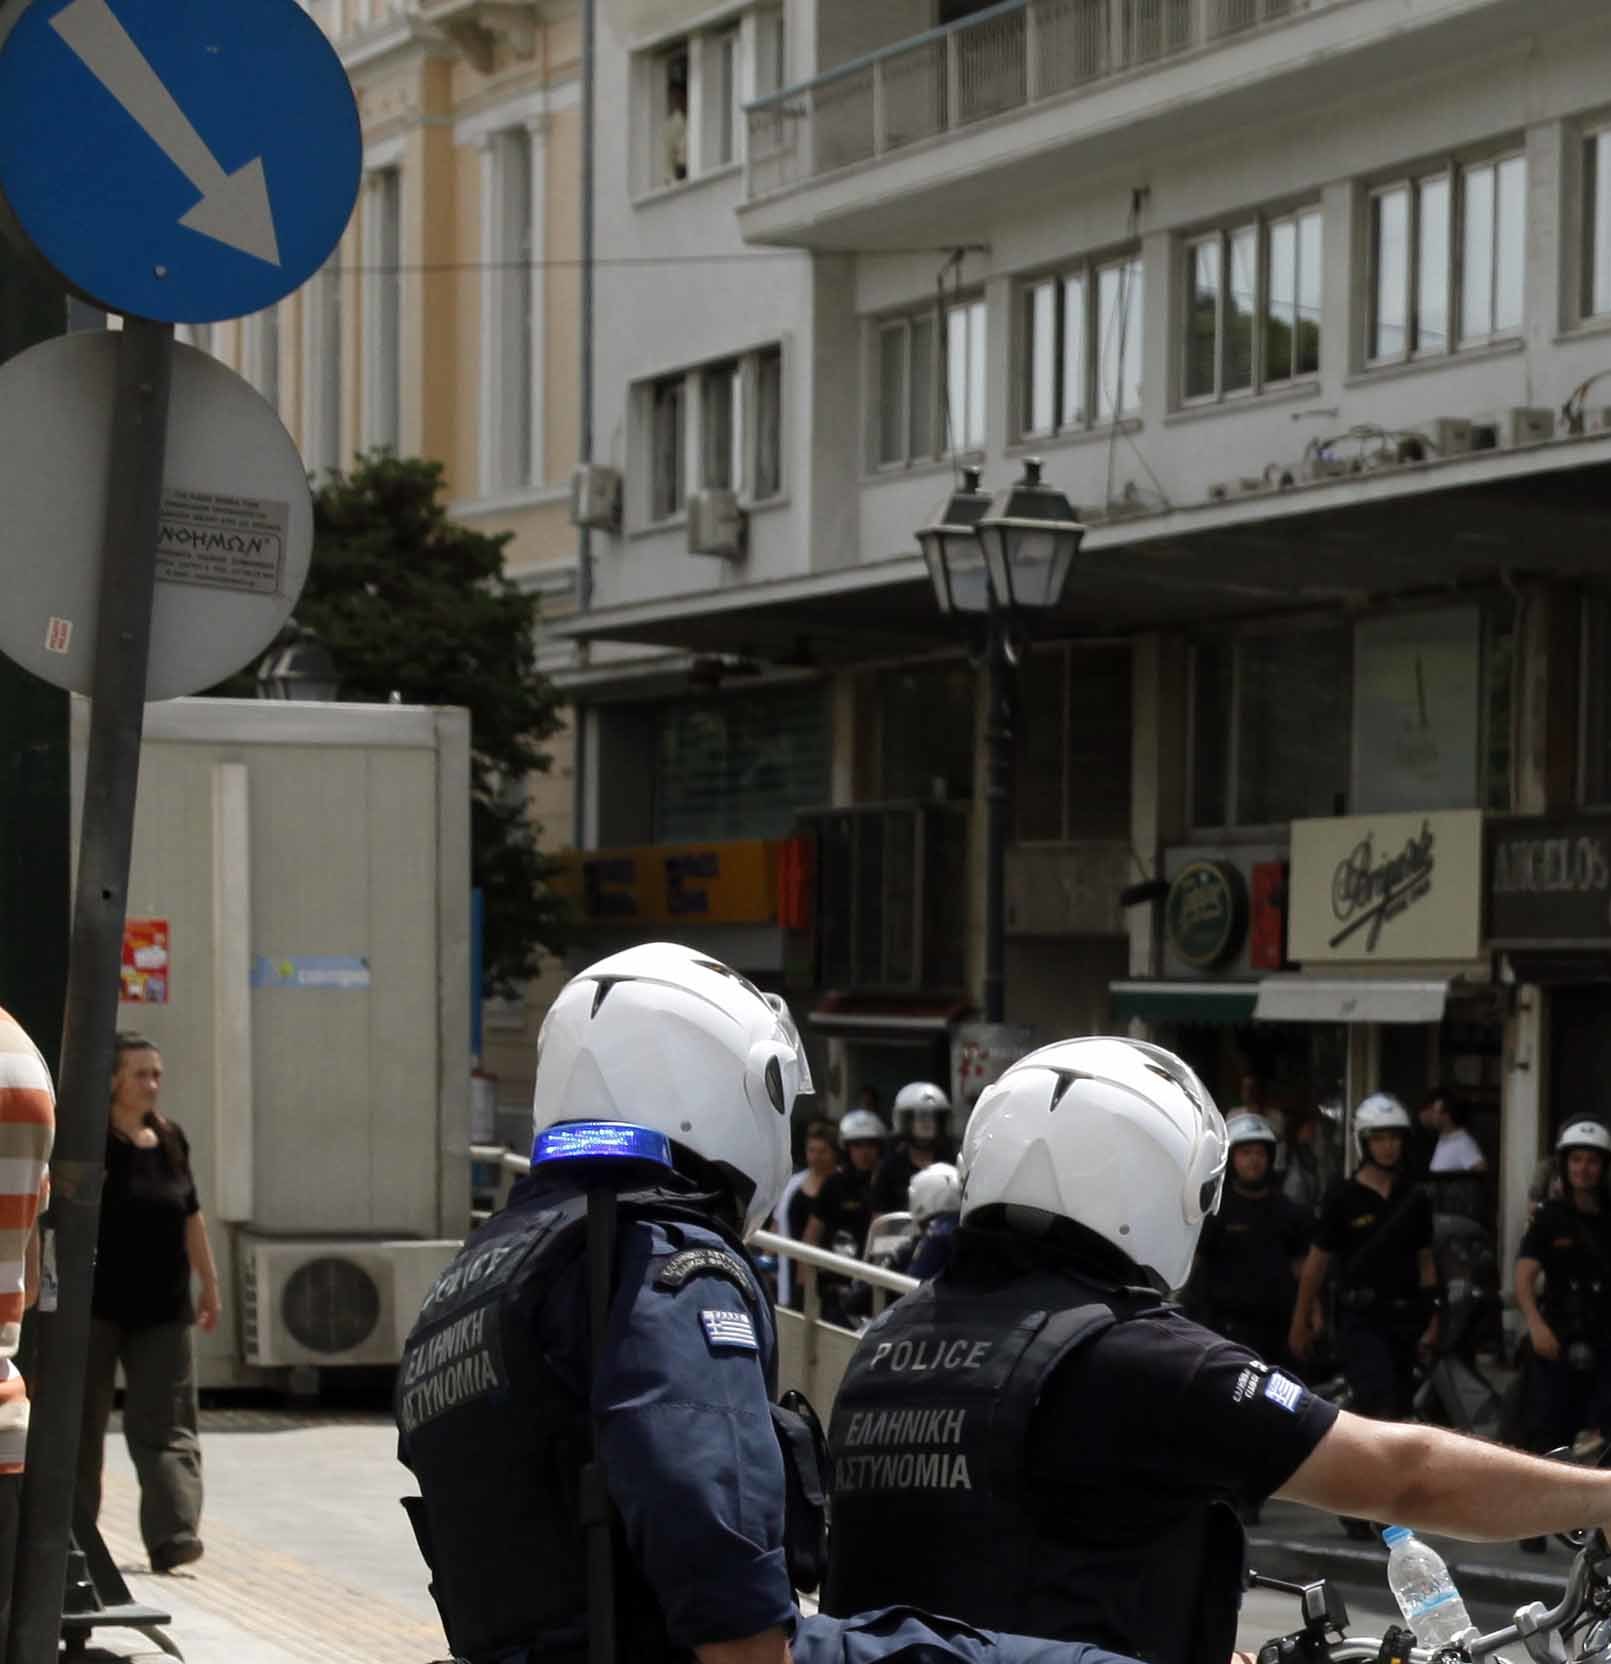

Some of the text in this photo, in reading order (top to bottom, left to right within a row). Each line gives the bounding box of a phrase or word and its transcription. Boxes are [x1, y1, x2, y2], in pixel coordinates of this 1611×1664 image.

[870, 1339, 993, 1371] POLICE
[845, 1408, 966, 1448] ΕΛΛΗΝΙΚΗ
[834, 1453, 972, 1491] ΑΣΤΥΝΟΜΙΑ
